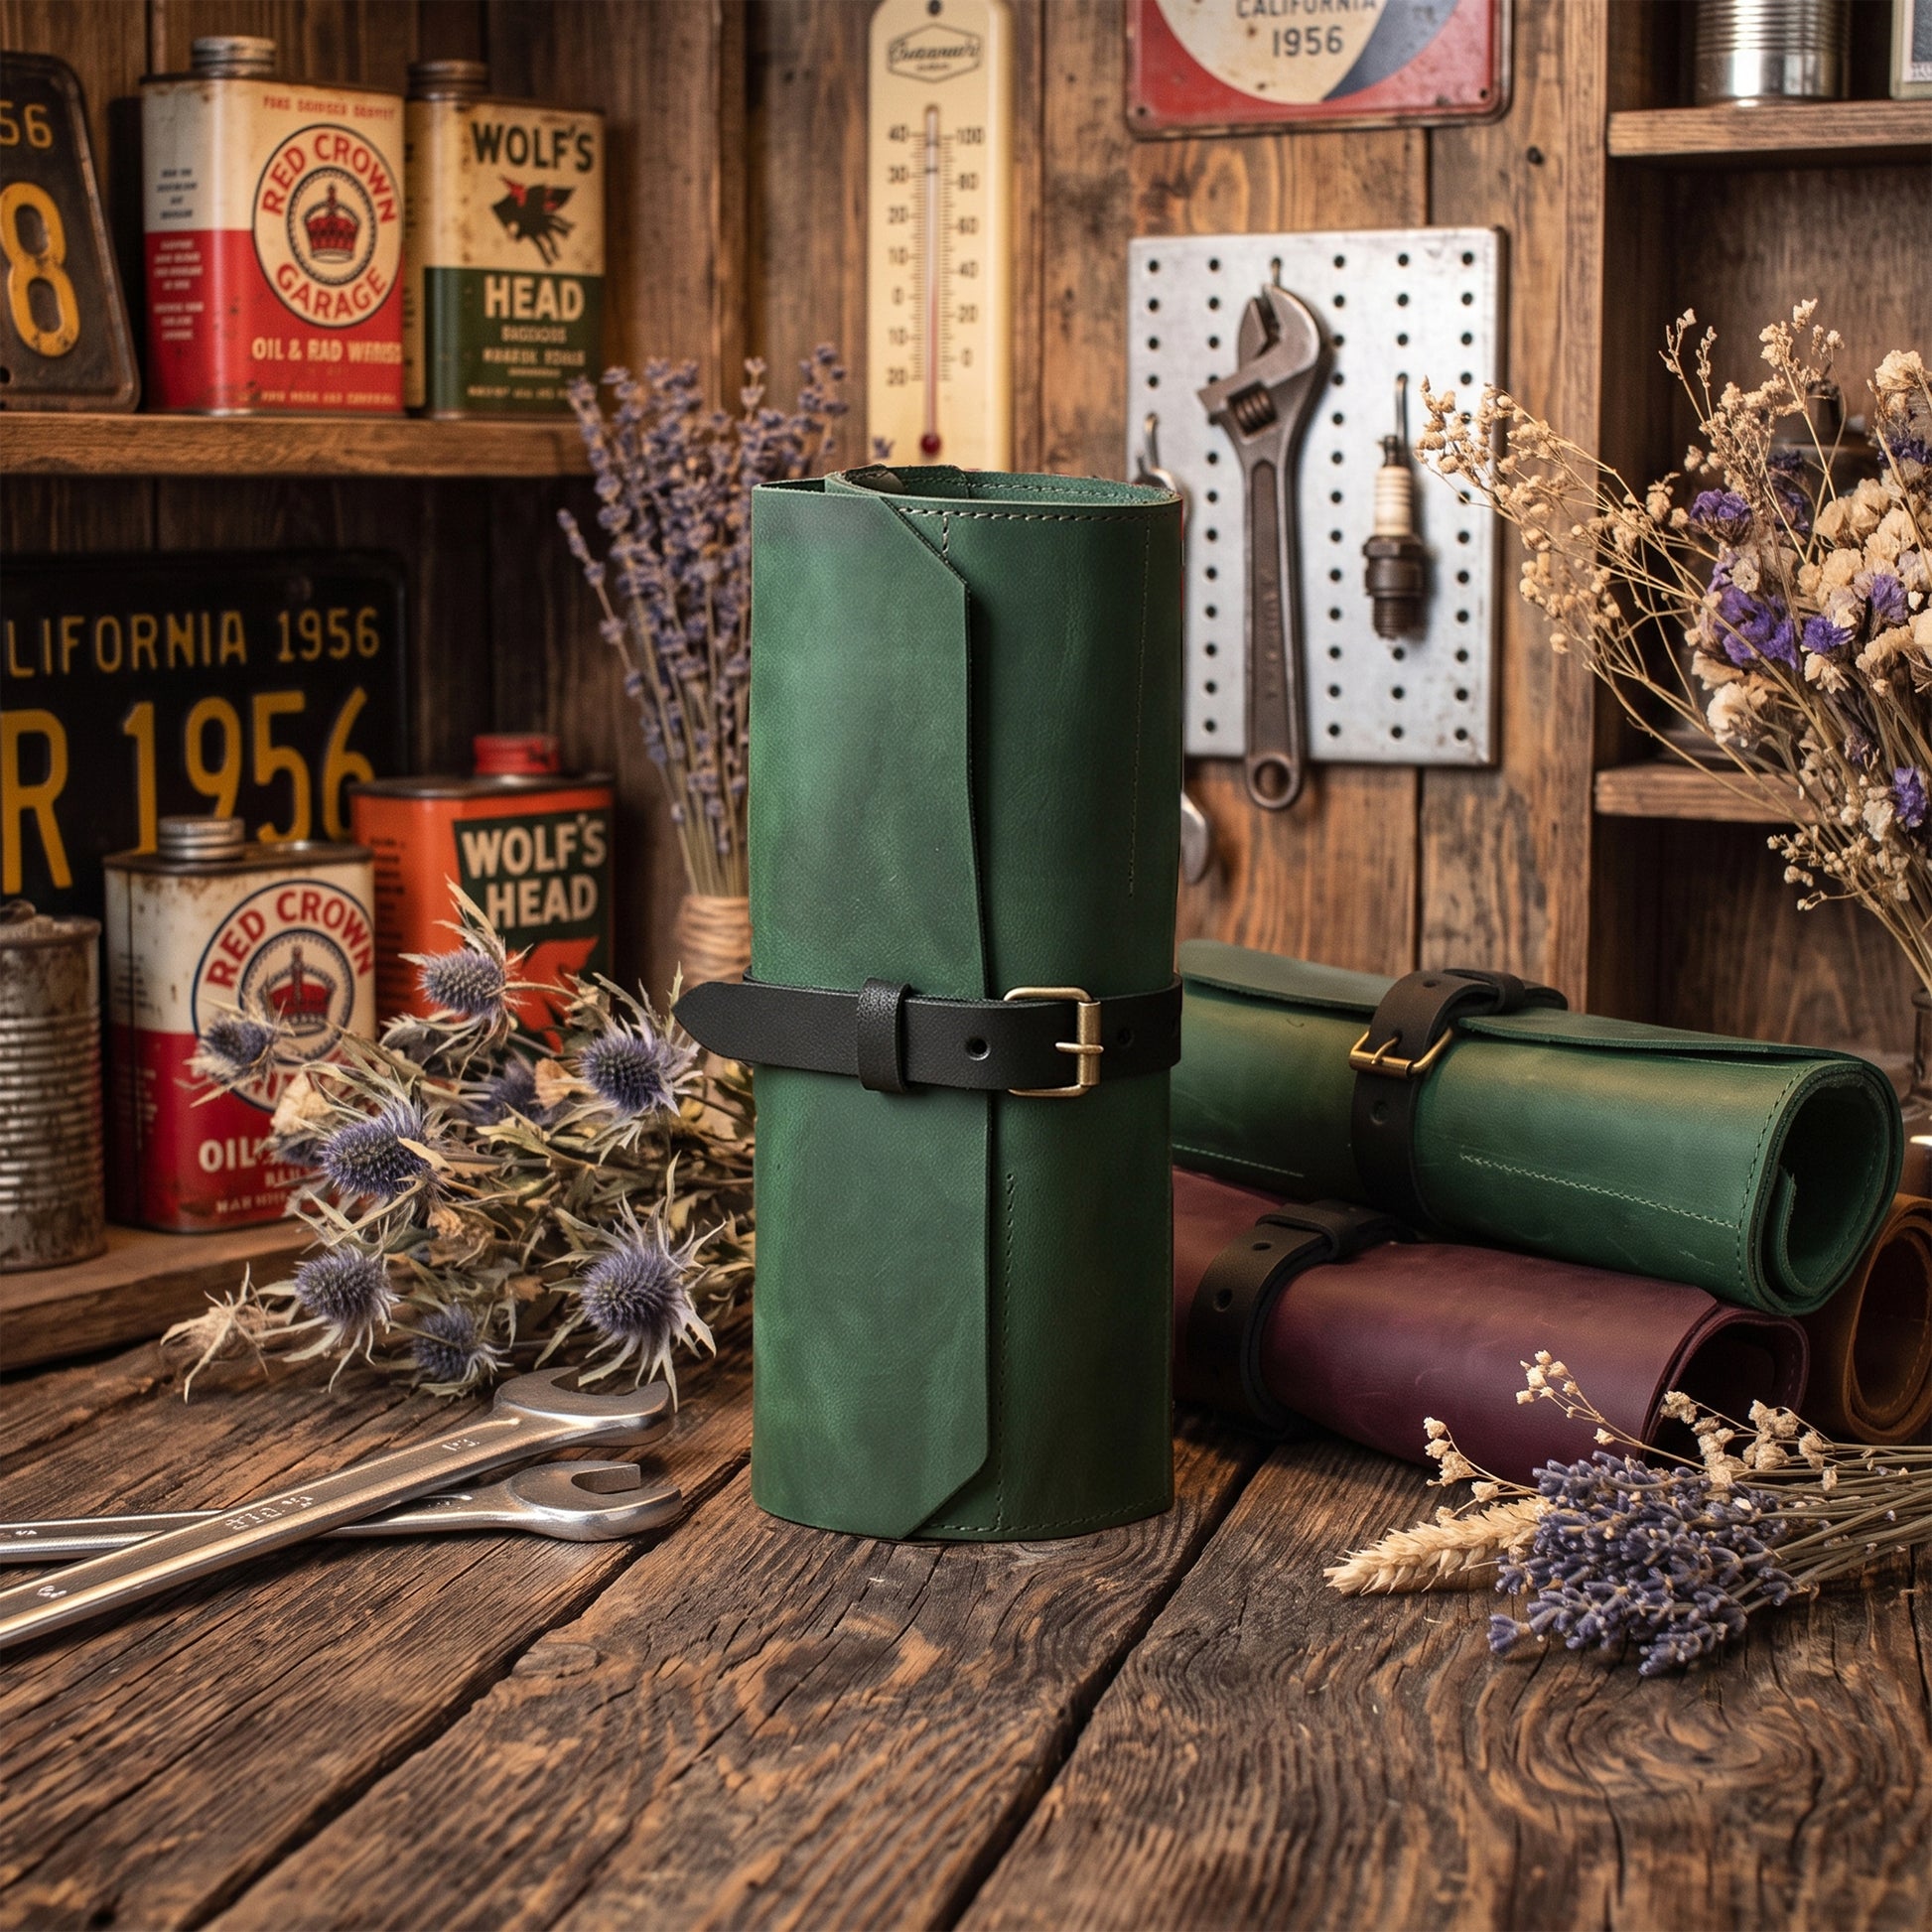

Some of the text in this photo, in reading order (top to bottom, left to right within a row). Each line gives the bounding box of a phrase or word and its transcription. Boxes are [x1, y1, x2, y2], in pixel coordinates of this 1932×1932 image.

[1273, 26, 1344, 57] 1956
[472, 120, 594, 173] WOLF'S
[889, 124, 984, 146] 40 100
[261, 147, 306, 215] RED
[314, 133, 397, 222] CROWN
[889, 165, 907, 184] 30
[889, 206, 907, 224] 20
[0, 182, 79, 356] 8
[889, 246, 907, 265] 10
[959, 260, 978, 279] 40
[276, 263, 387, 318] GARAGE
[483, 275, 585, 322] HEAD
[958, 304, 978, 324] 20
[251, 337, 285, 360] OIL
[277, 608, 379, 662] 1956
[0, 687, 375, 895] R 1956
[461, 814, 607, 879] WOLF'S
[485, 874, 598, 929] HEAD
[206, 909, 266, 989] RED
[276, 891, 373, 978] CROWN
[199, 1139, 256, 1173] OIL
